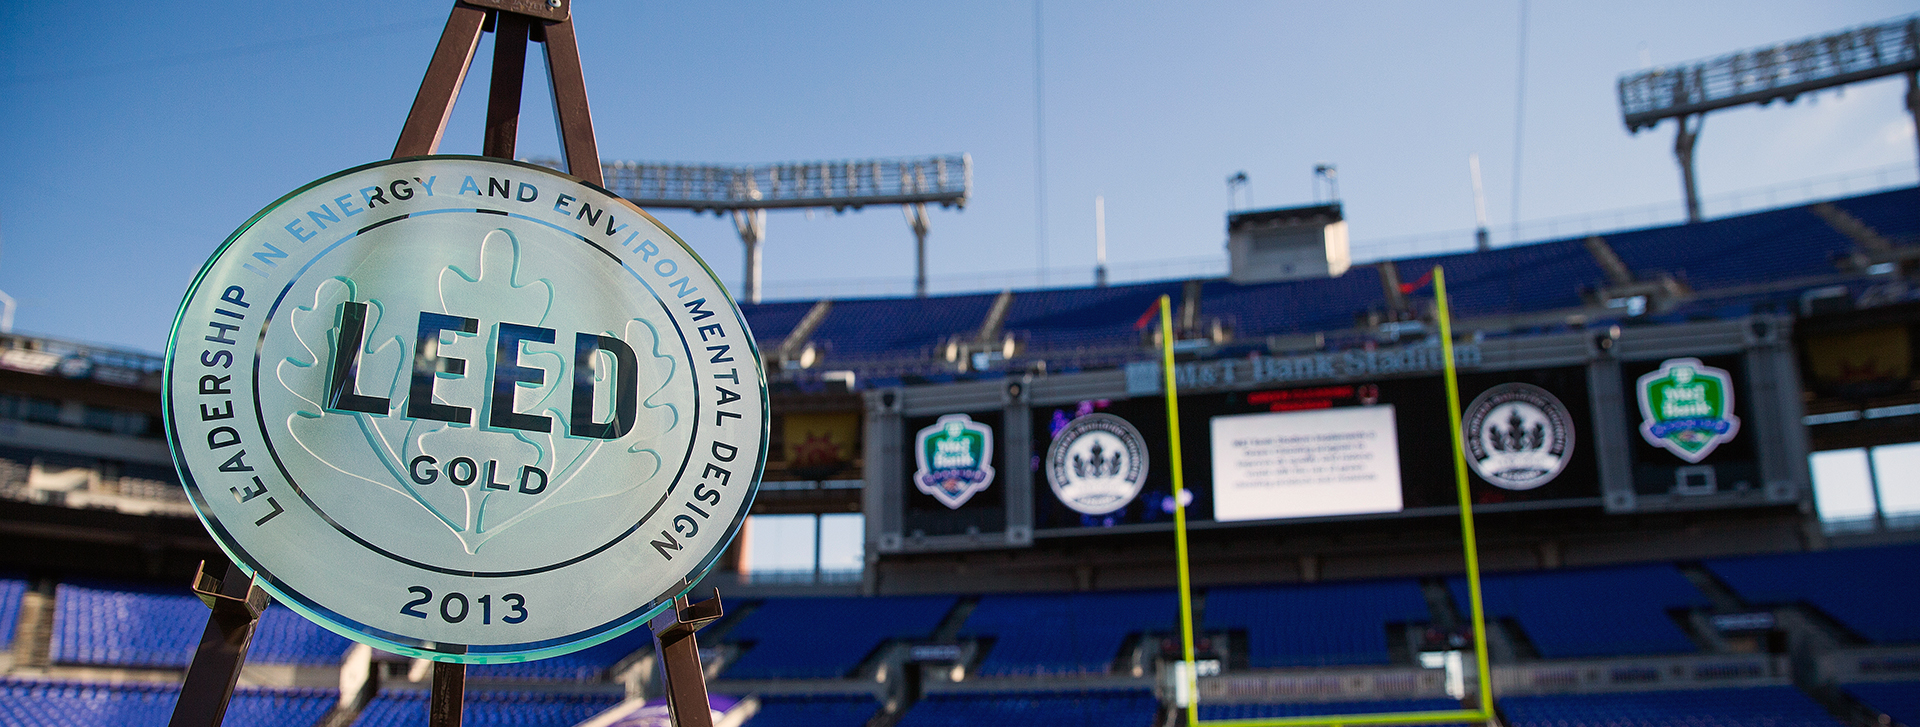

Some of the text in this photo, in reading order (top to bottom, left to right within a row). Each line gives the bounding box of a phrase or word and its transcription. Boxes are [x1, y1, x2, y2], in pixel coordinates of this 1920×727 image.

[199, 175, 742, 561] LEADERSHIP IN ENERGY AND ENVIRONMENTAL DESIGN
[326, 301, 639, 440] LEED
[1251, 353, 1335, 382] Bank
[409, 454, 549, 495] GOLD
[400, 586, 529, 625] 2013
